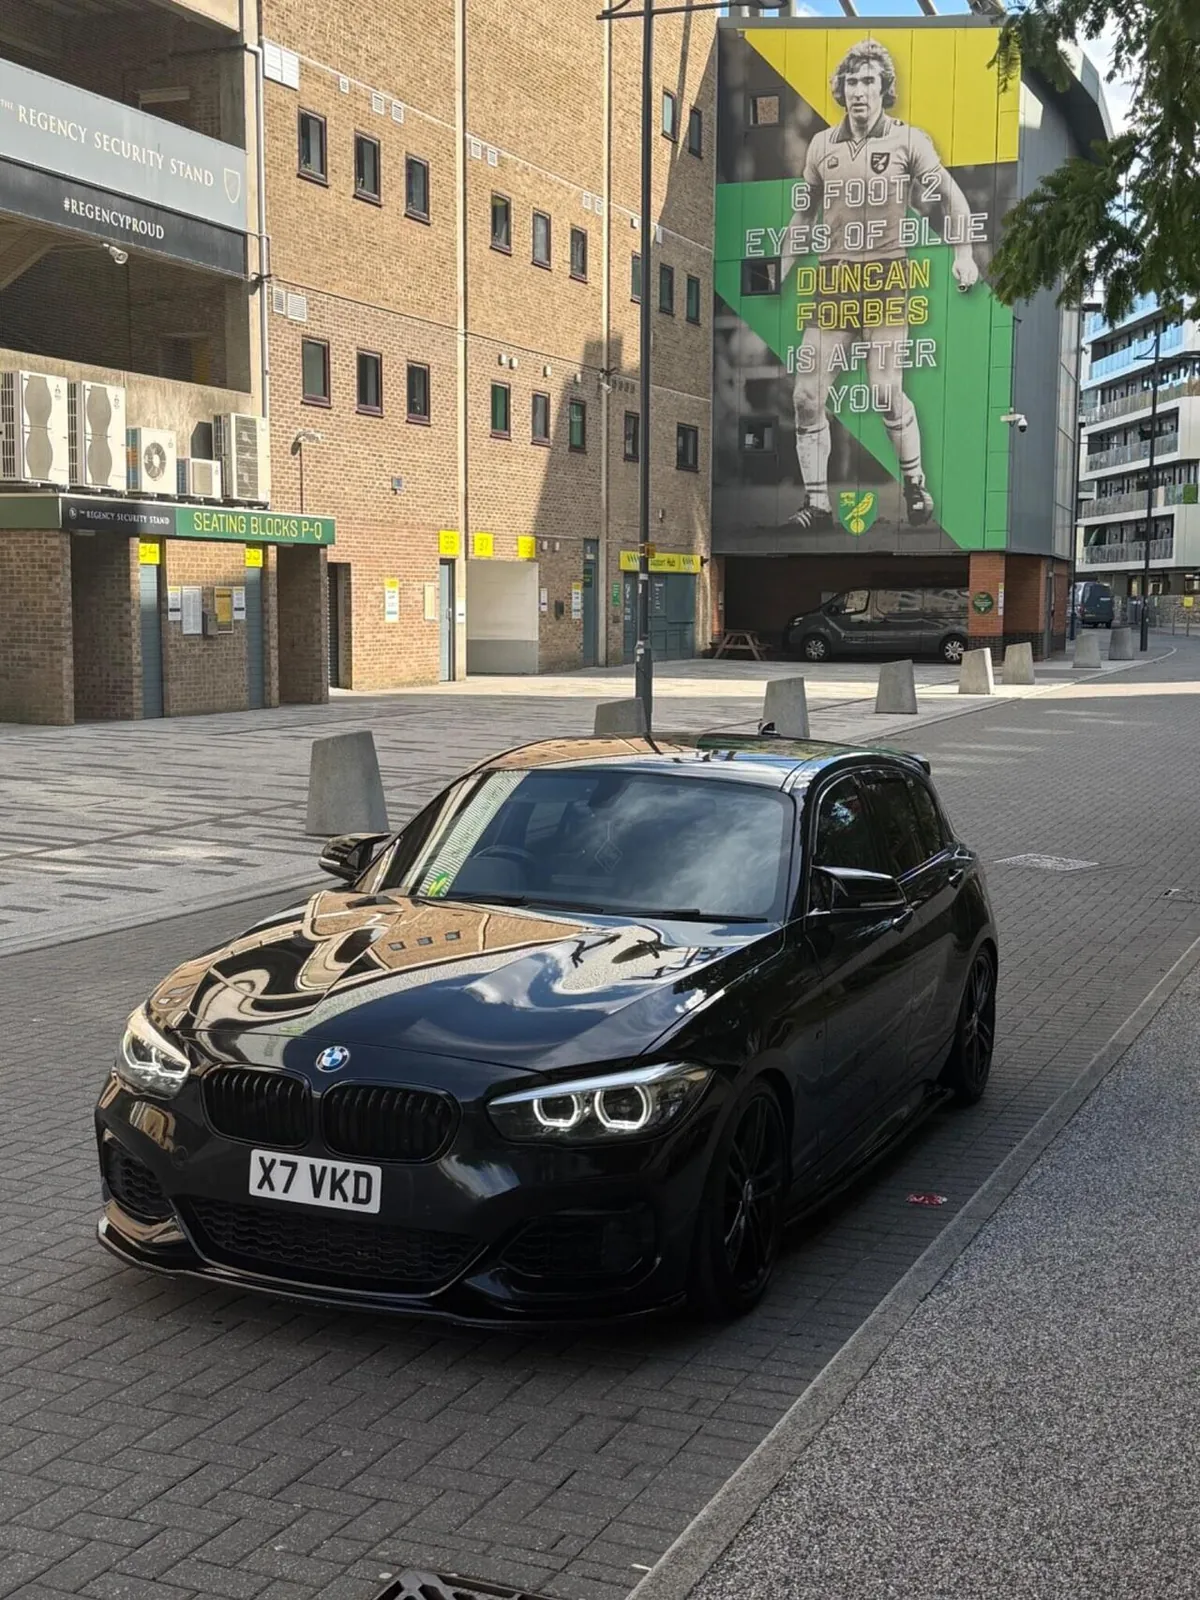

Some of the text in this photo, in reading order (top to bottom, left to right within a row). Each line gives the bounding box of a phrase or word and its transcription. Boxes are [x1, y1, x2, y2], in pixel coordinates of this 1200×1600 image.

[18, 104, 87, 144] REGENCY
[94, 132, 164, 170] SECURITY
[170, 158, 214, 186] STAND
[791, 172, 941, 211] 6 FOOT 2
[63, 197, 165, 240] #REGENCYPROUD
[745, 213, 988, 257] EYES OF BLUE
[796, 259, 930, 295] DUNCAN
[796, 296, 928, 331] FORBES
[787, 338, 936, 373] IS AFTER
[828, 384, 892, 413] YOU
[149, 516, 170, 525] STAND
[194, 512, 322, 540] SEATING BLOCKS P-Q
[257, 1156, 372, 1205] X7 VKD
